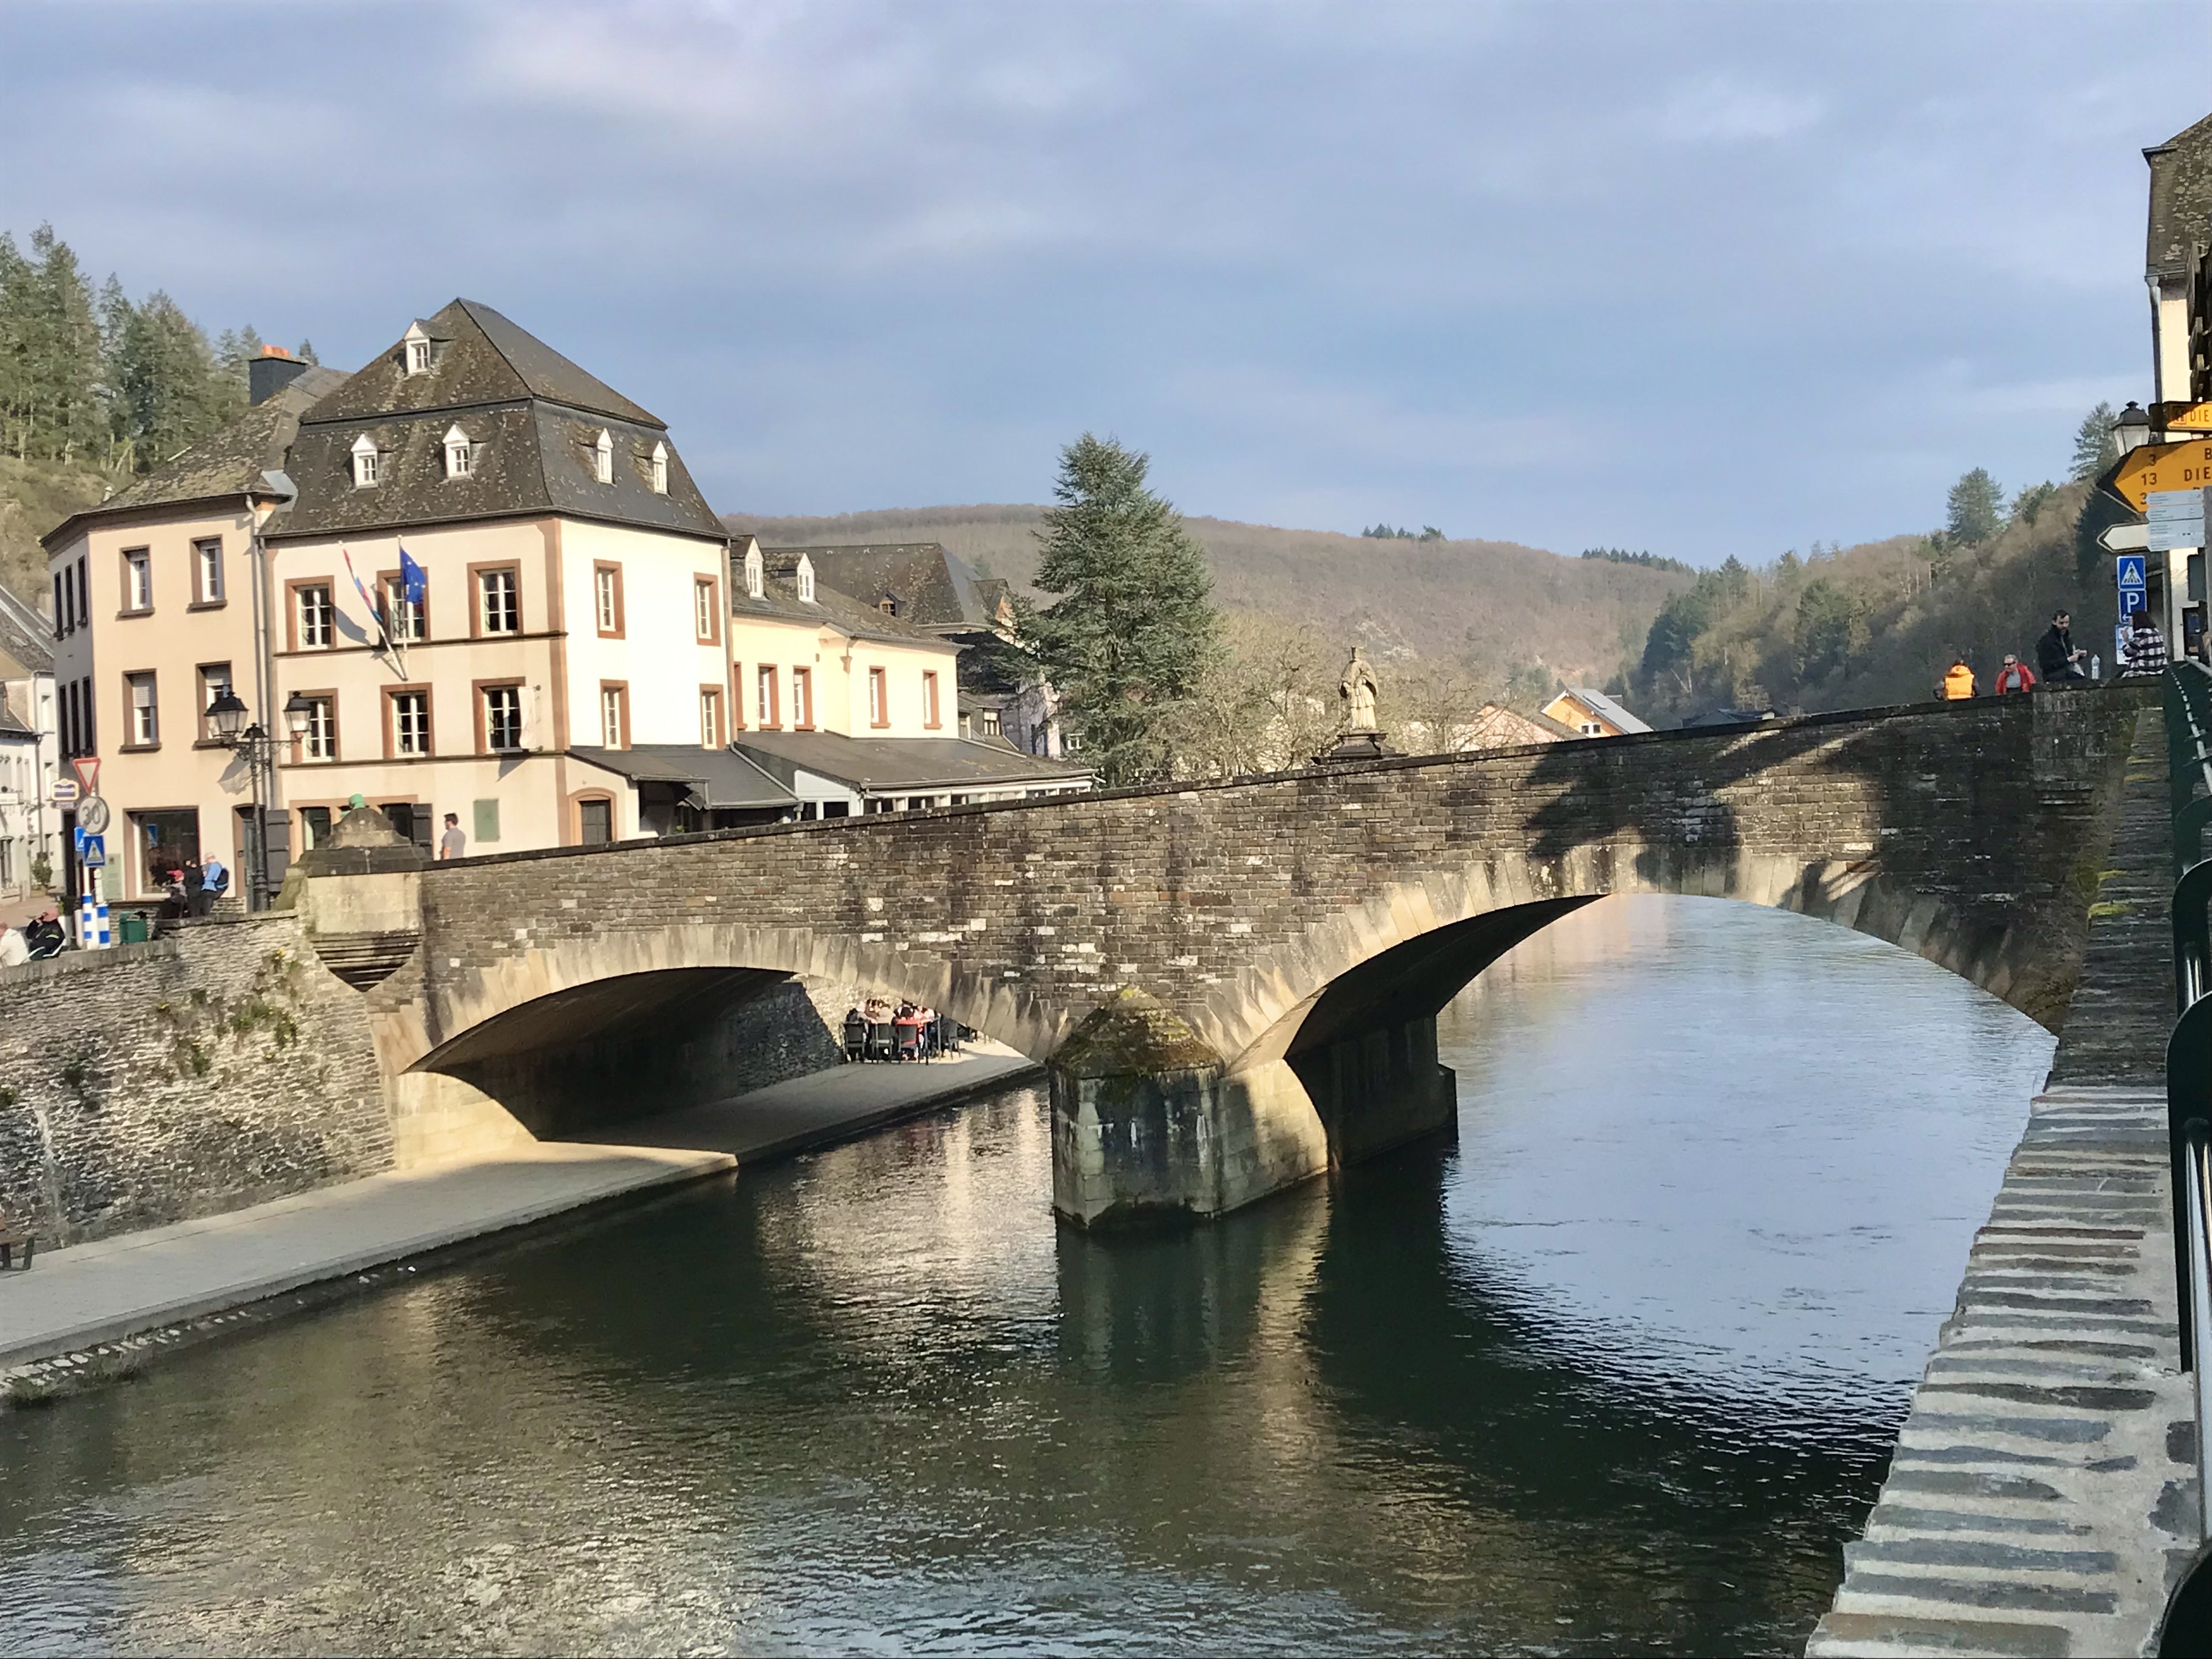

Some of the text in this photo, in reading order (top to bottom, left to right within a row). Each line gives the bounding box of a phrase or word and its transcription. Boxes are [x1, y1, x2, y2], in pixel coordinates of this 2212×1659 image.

[2190, 409, 2210, 422] DIE
[2149, 454, 2157, 466] 3
[2141, 466, 2211, 486] 13 DIE
[2126, 592, 2140, 613] P
[82, 805, 101, 825] 30
